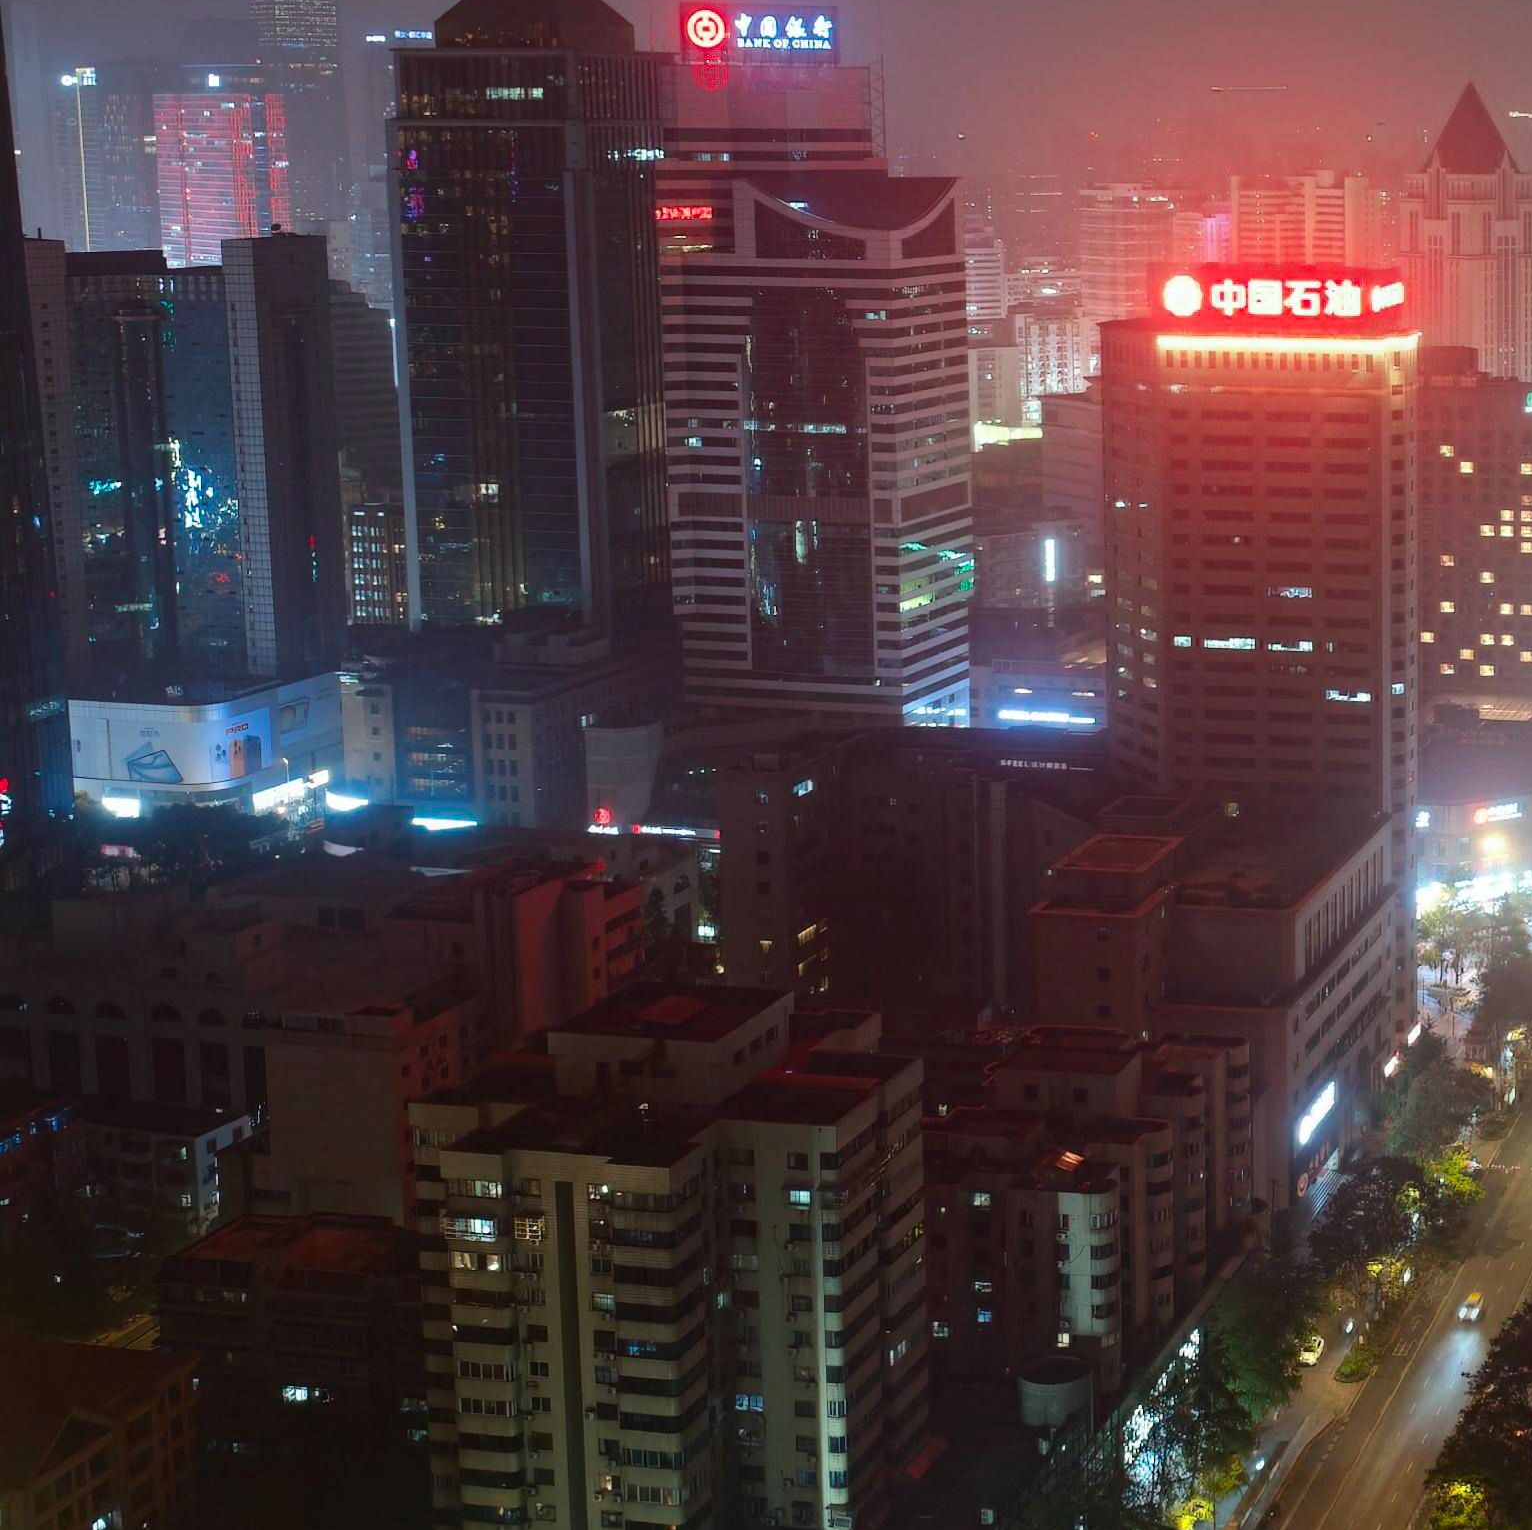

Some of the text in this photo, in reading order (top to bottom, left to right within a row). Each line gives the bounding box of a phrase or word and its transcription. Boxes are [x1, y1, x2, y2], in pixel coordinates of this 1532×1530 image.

[735, 13, 833, 38] 中国银行
[737, 38, 832, 51] BANK OF CHINA
[1210, 278, 1362, 318] 中国石油
